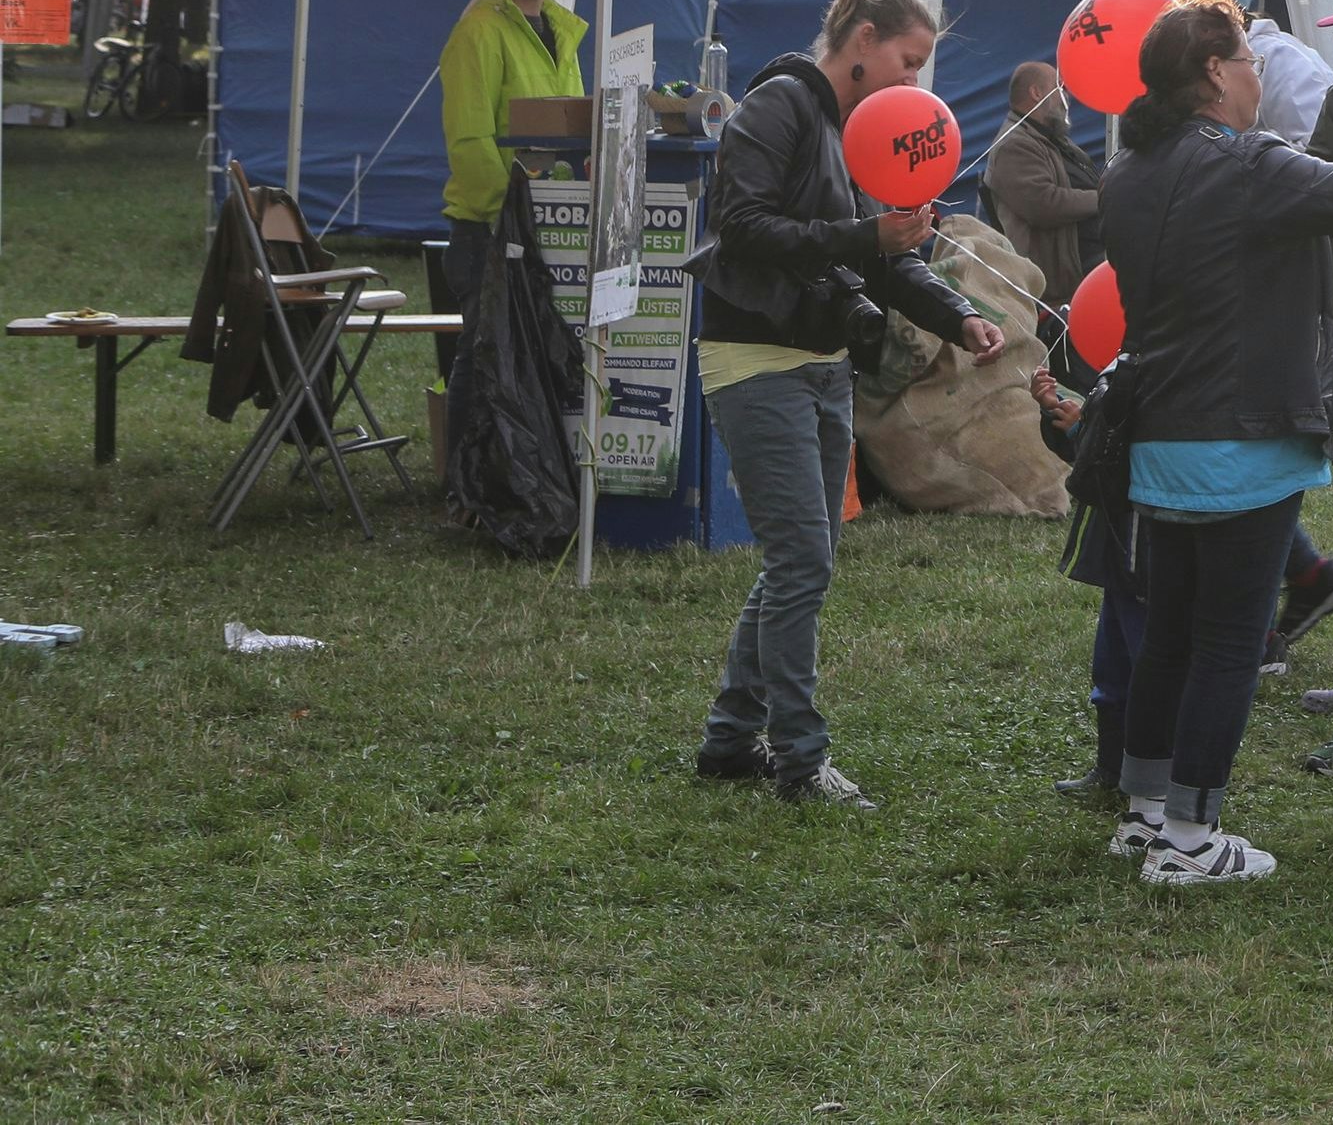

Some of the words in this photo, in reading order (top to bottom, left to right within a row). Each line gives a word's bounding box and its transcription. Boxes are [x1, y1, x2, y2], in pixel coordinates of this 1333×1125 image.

[908, 140, 947, 172] plus
[613, 333, 680, 346] ATTWENGER
[642, 360, 674, 369] ELEFANT
[608, 454, 638, 465] OPEN
[640, 456, 656, 466] AIR
